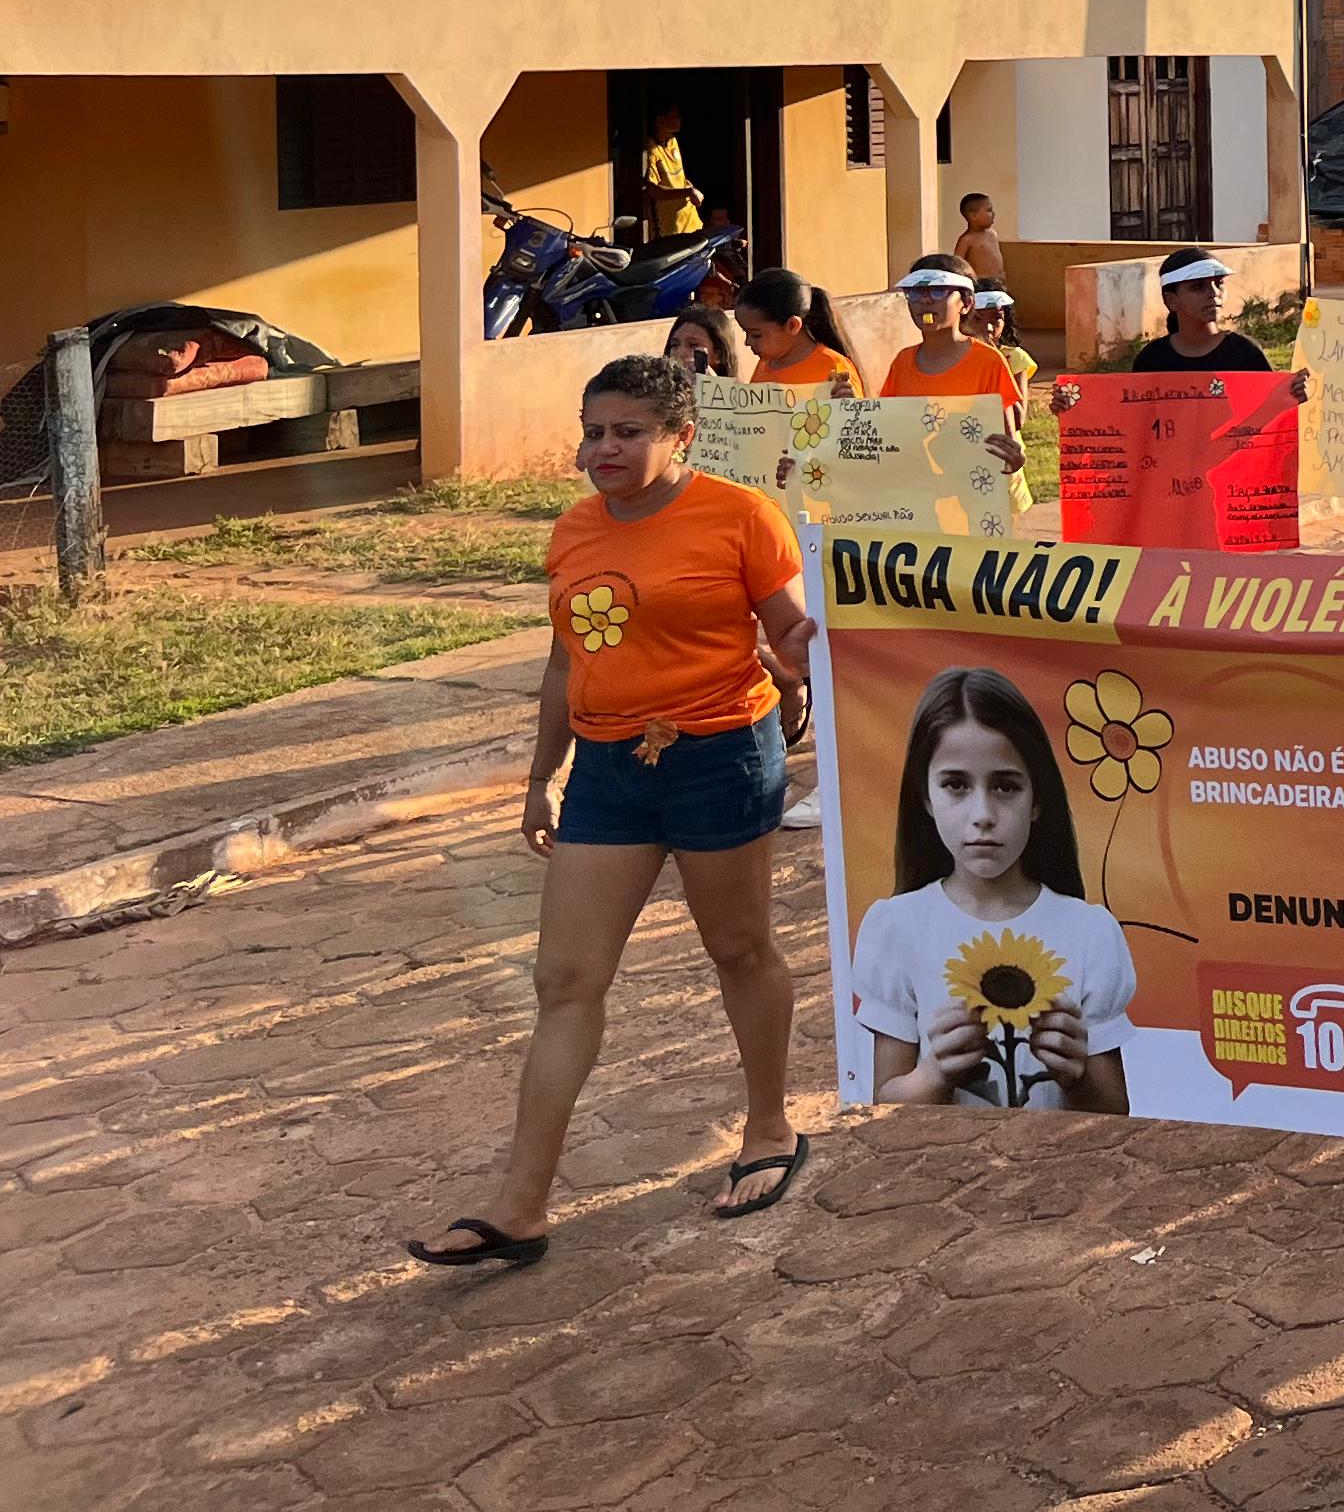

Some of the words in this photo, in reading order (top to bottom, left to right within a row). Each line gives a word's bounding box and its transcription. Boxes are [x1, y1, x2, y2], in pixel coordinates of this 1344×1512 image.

[831, 538, 953, 611] DIGA
[970, 541, 1120, 624] NÃO!
[1150, 561, 1193, 628] À
[1188, 746, 1268, 772] ABUSO
[1273, 742, 1328, 774] NÃO
[1212, 989, 1284, 1021] DISQUE
[1213, 1018, 1286, 1044] DIREITOS
[1215, 1040, 1288, 1066] HUMANOS
